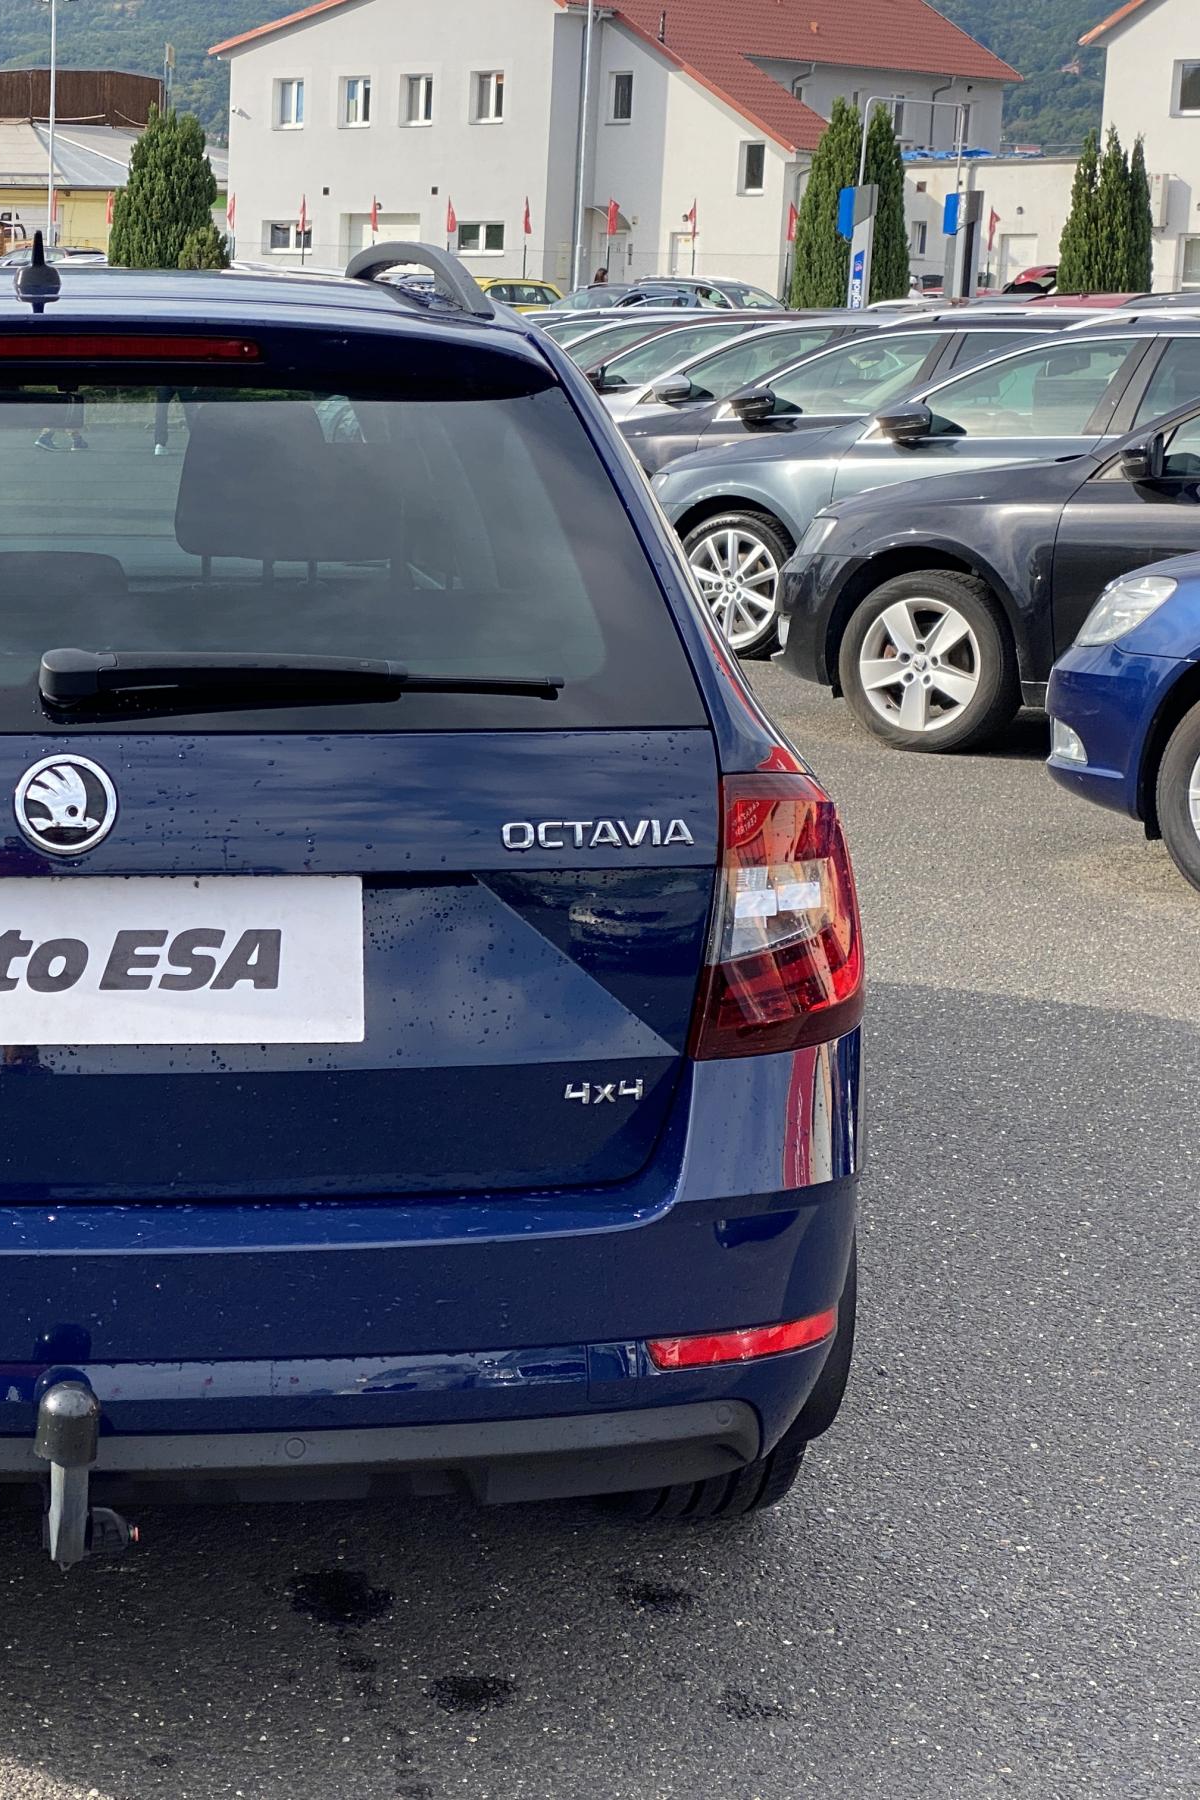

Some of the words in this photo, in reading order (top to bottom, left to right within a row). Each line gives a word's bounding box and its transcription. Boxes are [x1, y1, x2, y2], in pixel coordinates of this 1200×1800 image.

[502, 818, 695, 849] OCTAVIA
[99, 928, 282, 991] ESA
[564, 1078, 643, 1105] 4x4
